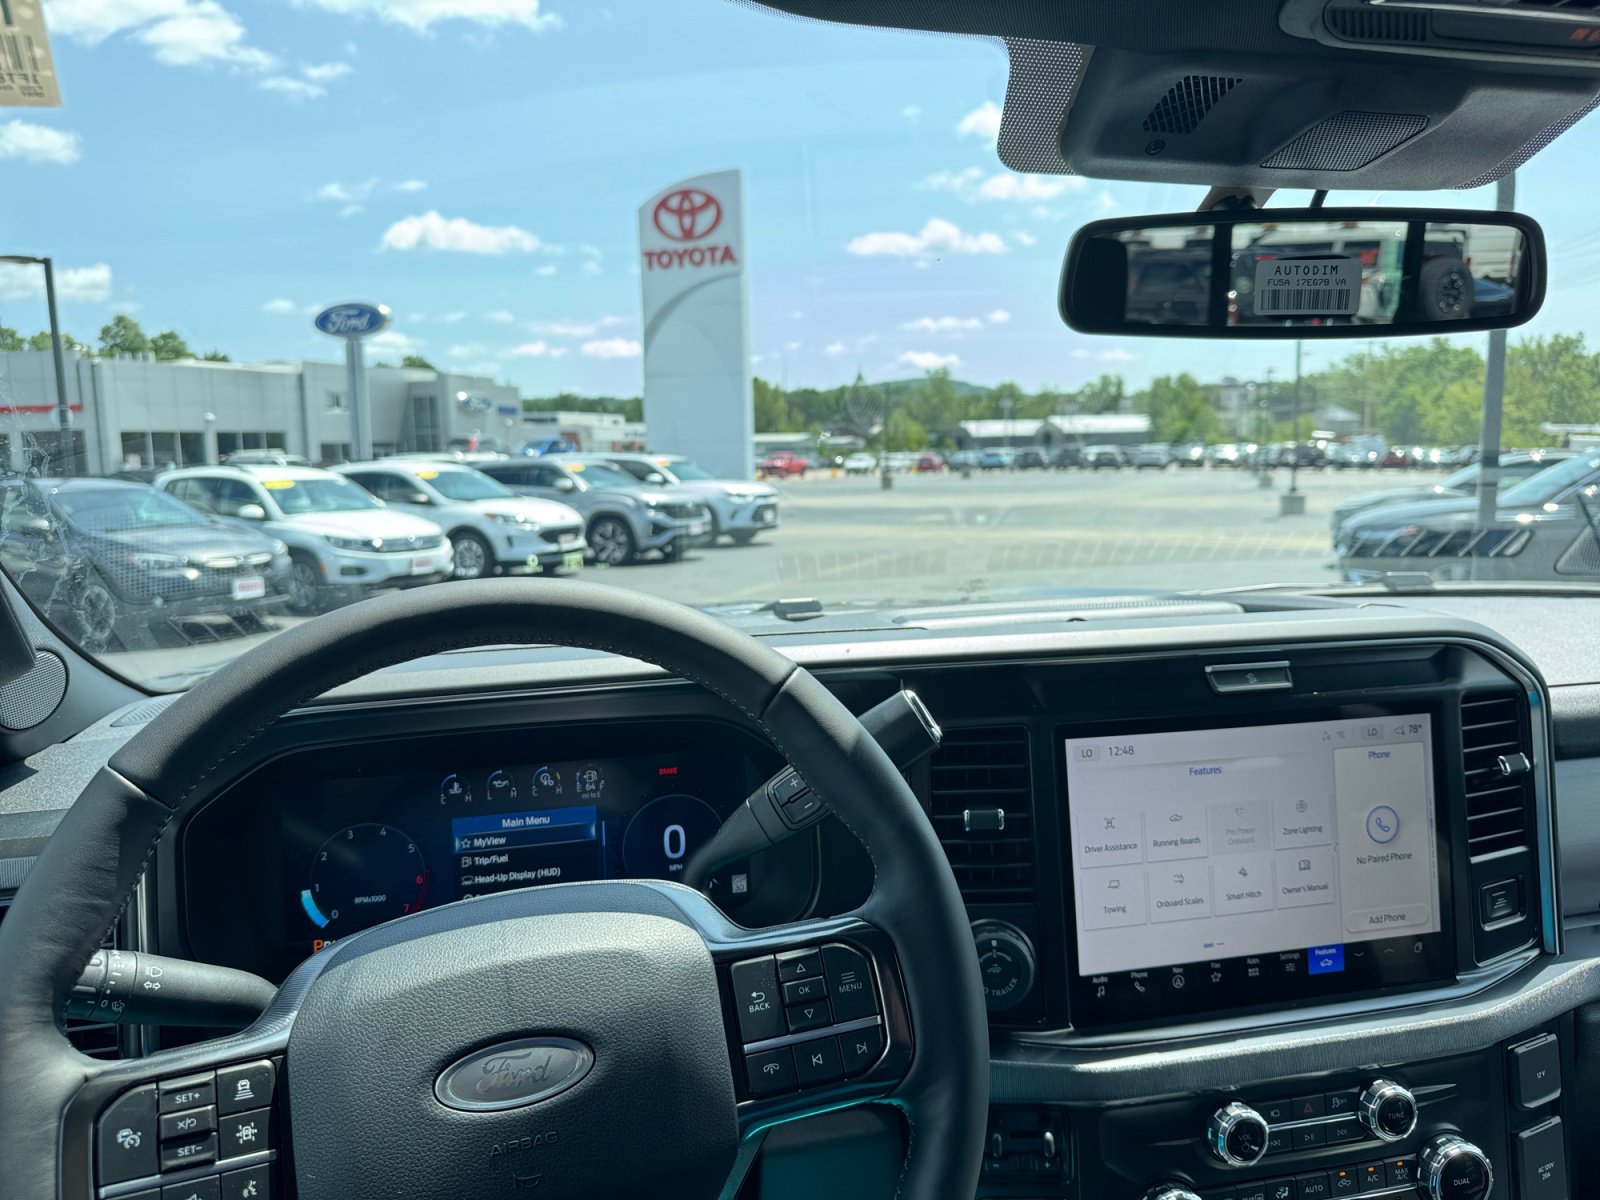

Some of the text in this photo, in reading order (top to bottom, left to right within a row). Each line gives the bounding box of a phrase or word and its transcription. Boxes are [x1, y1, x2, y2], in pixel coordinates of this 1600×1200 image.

[643, 244, 736, 271] TOYOTA
[1274, 265, 1338, 276] AUTODIM
[327, 309, 370, 332] Ford
[1367, 728, 1377, 737] LO
[1081, 749, 1093, 758] LO
[1108, 746, 1134, 757] 12:48
[1368, 751, 1391, 759] Phone
[1189, 767, 1222, 776] Features
[502, 816, 550, 828] Main Menu
[348, 830, 354, 839] 3
[1282, 825, 1323, 836] Zone Lighting
[473, 837, 506, 848] MyView
[663, 824, 686, 859] 0
[1152, 837, 1201, 847] Running Boards
[408, 844, 415, 853] 5
[1084, 843, 1138, 854] Driver Assistance
[321, 852, 328, 861] 2
[474, 854, 509, 866] Trip/Fuel
[1357, 852, 1412, 864] No Paired Phone
[669, 864, 683, 872] MPH
[416, 875, 423, 884] 6
[474, 867, 561, 884] Head-Up Display (HUD)
[1306, 883, 1328, 892] Manual
[1226, 890, 1262, 901] Smart Hitch
[1156, 897, 1204, 908] Onboard Scales
[404, 904, 410, 913] 7
[1103, 905, 1127, 914] Towing
[331, 910, 339, 919] 0
[1369, 913, 1406, 924] Add Phone
[1092, 976, 1108, 984] Audio
[798, 985, 811, 995] OK
[838, 982, 862, 993] MENU
[992, 977, 1018, 996] TRAILER
[749, 1002, 771, 1013] BACK
[476, 1052, 552, 1094] Ford
[175, 1093, 201, 1104] SET+
[1387, 1111, 1405, 1120] TUNE
[1238, 1133, 1252, 1141] VOL
[491, 1131, 559, 1157] AIRBAG
[177, 1145, 202, 1157] SET-
[1367, 1174, 1379, 1182] A/C
[1396, 1173, 1408, 1181] A/C
[1453, 1178, 1471, 1186] DUAL
[1305, 1185, 1323, 1193] AUTO
